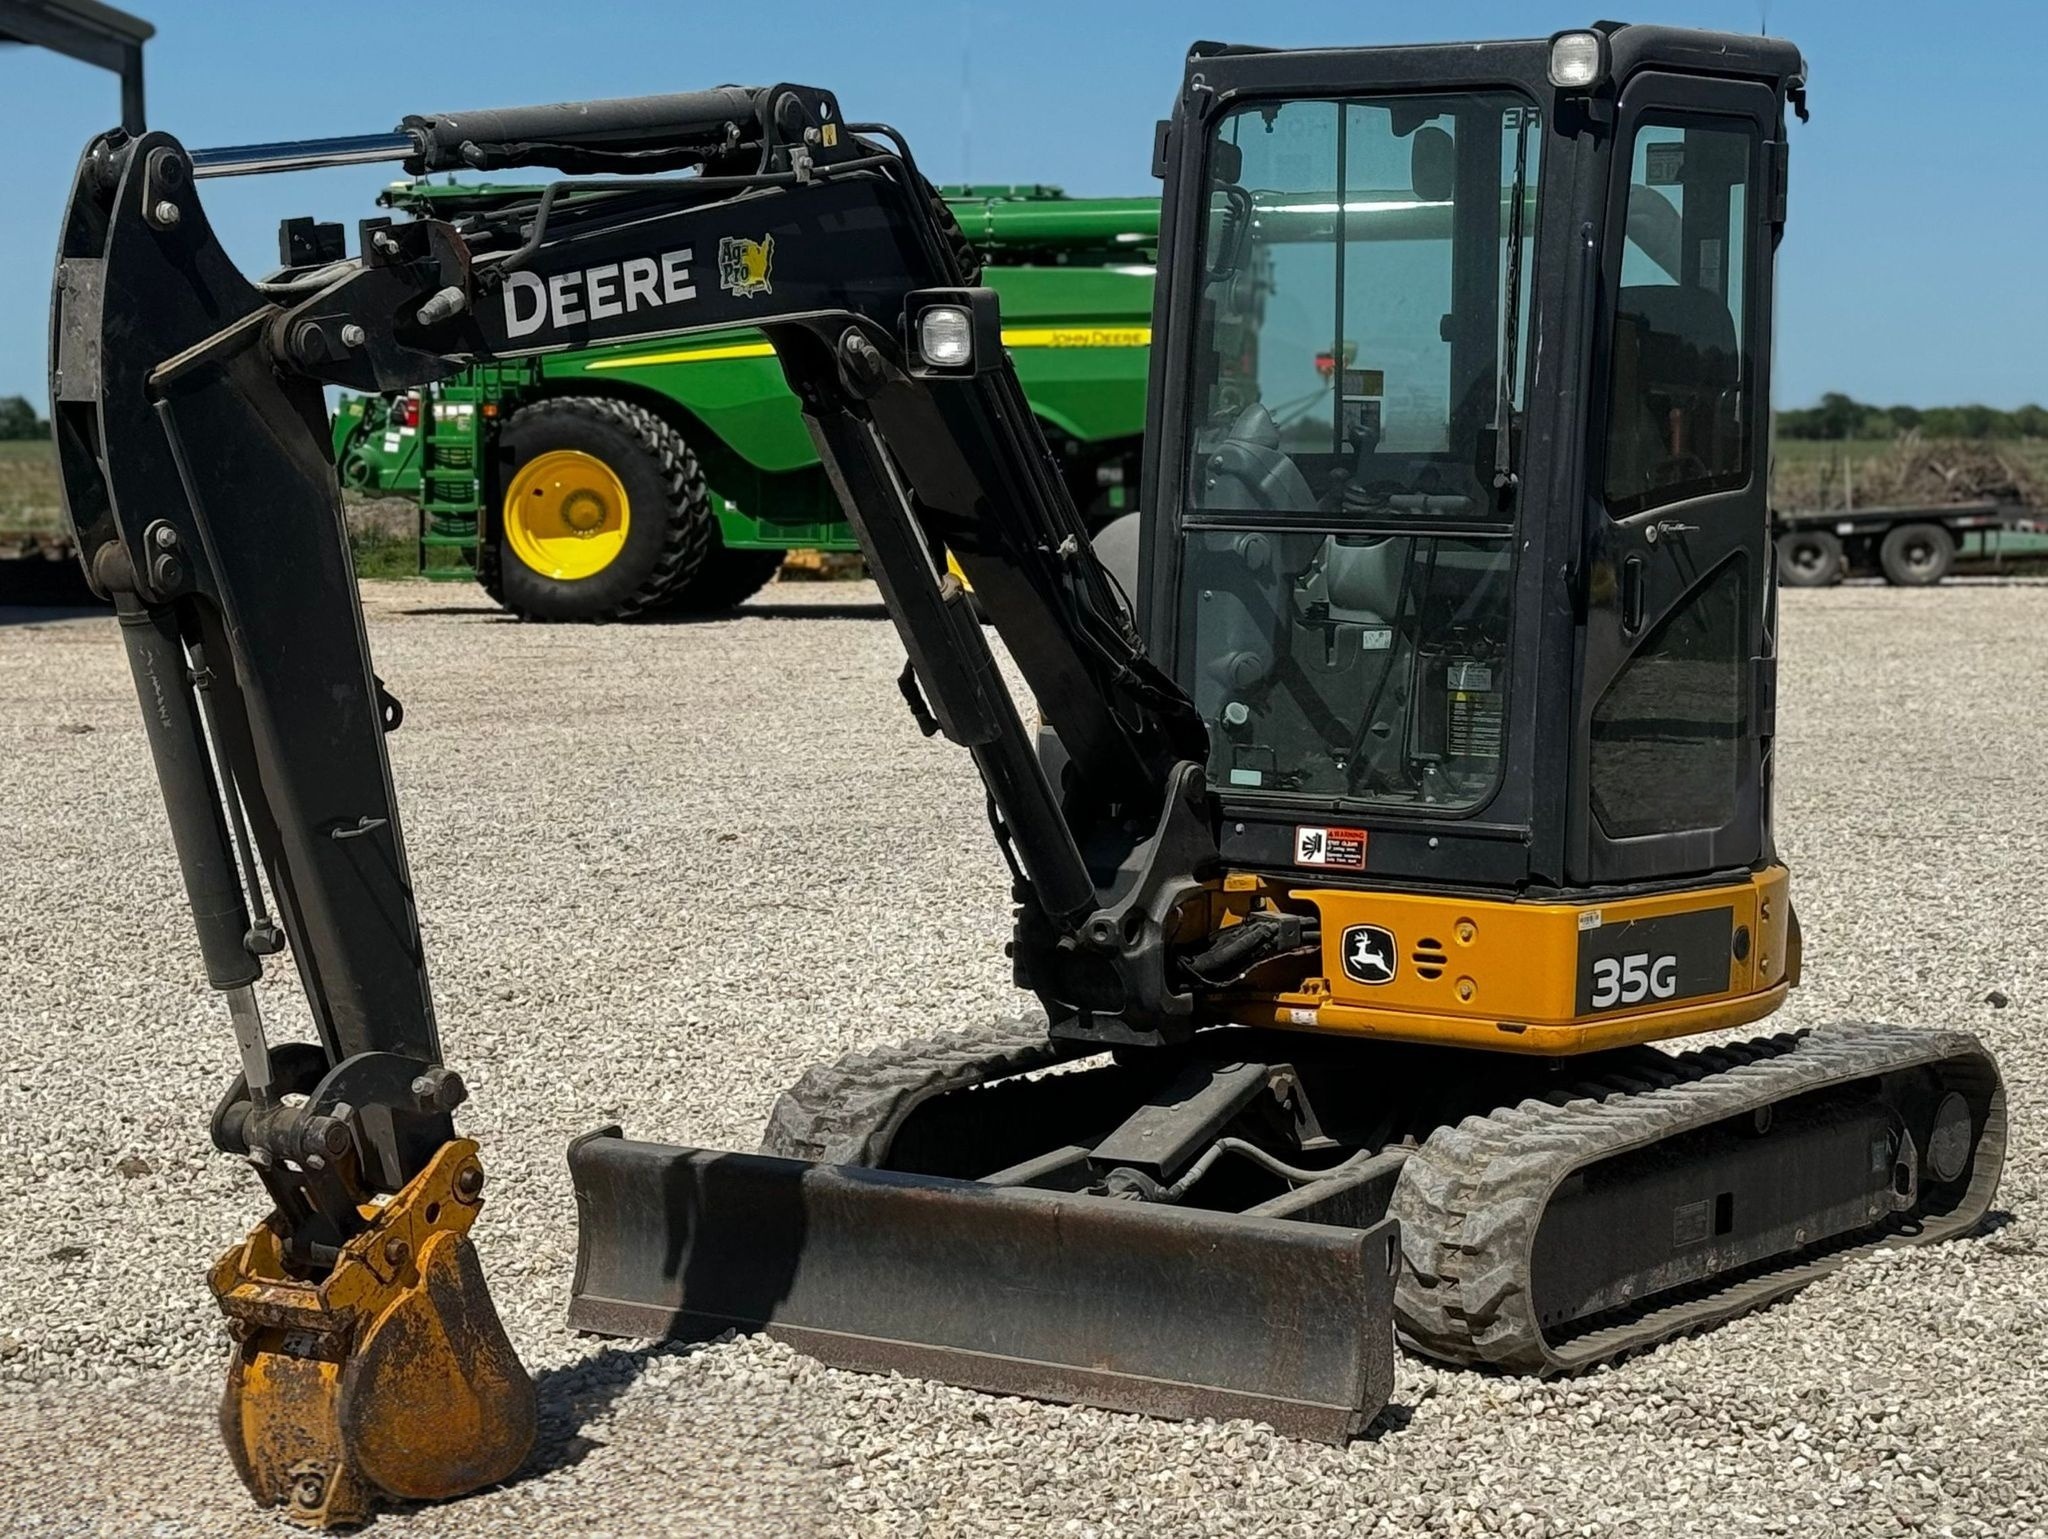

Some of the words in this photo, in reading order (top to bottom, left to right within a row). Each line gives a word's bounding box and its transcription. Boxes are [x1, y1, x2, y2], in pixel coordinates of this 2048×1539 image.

[723, 264, 749, 284] Pro
[502, 249, 696, 338] DEERE
[1050, 332, 1089, 344] JOHN
[1092, 331, 1142, 343] DEERE
[1334, 831, 1364, 839] WARNING
[1592, 953, 1677, 1008] 35G
